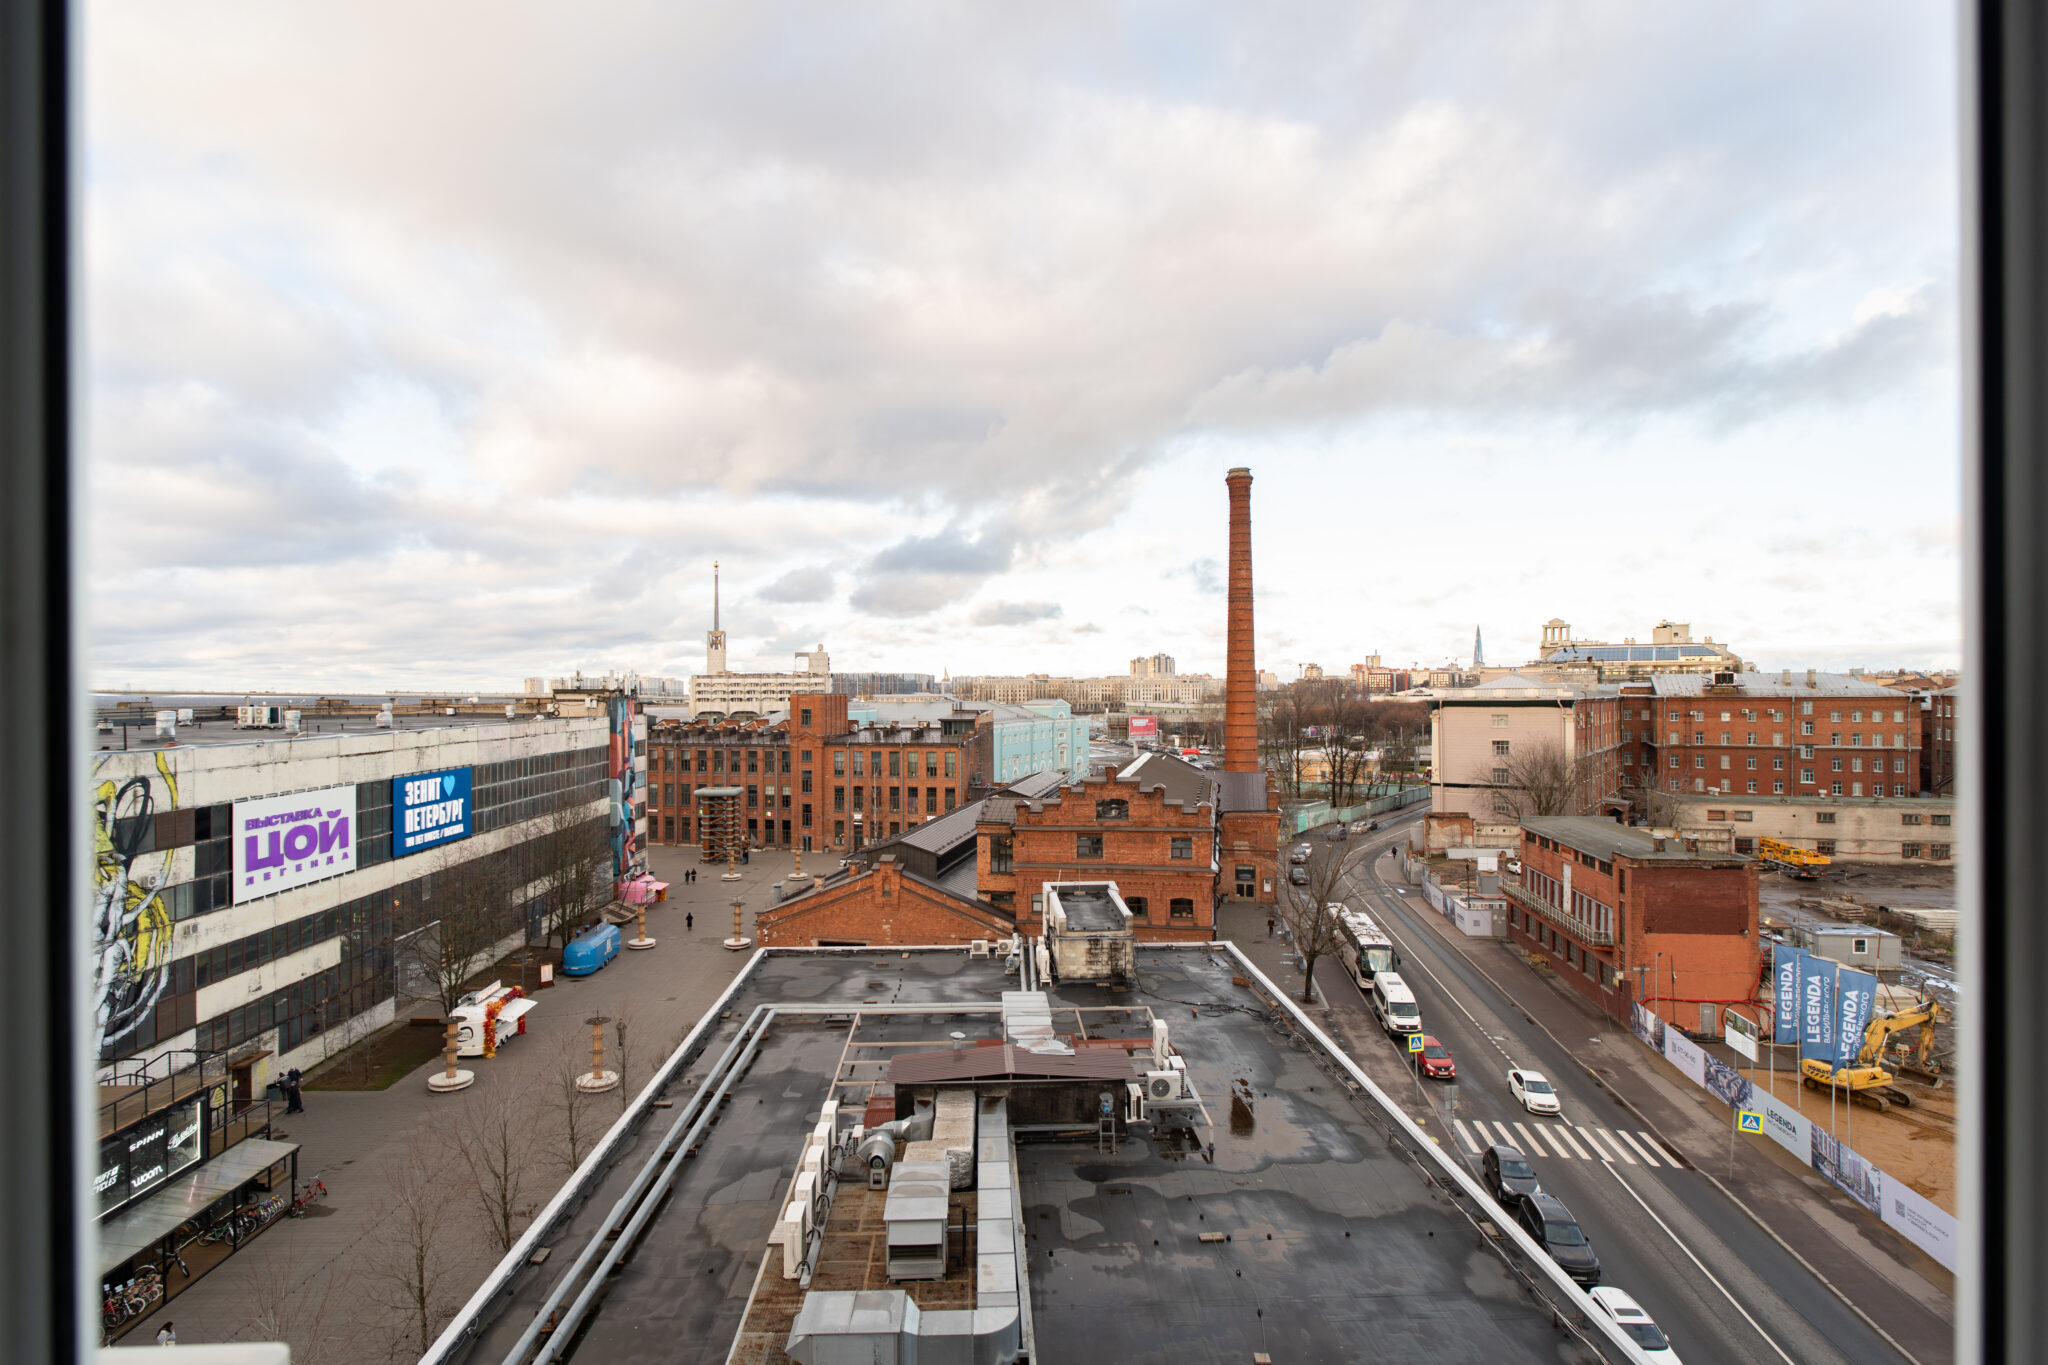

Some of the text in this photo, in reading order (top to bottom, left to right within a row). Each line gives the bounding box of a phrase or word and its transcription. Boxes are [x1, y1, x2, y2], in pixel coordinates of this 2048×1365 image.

[405, 777, 441, 806] ЗЕНИТ
[245, 807, 322, 831] ВЫСТАВКА
[404, 798, 464, 834] ПЕТЕРБУРГ
[245, 809, 349, 873] ЦОЙ
[245, 852, 349, 886] ЛЕГЕНДА
[1781, 961, 1794, 1029] LEGENDA
[1806, 975, 1821, 1043] LEGENDA
[1840, 990, 1859, 1060] LEGENDA
[1766, 1106, 1797, 1135] LEGENDA
[129, 1128, 164, 1152] SPINN
[131, 1165, 163, 1188] woom
